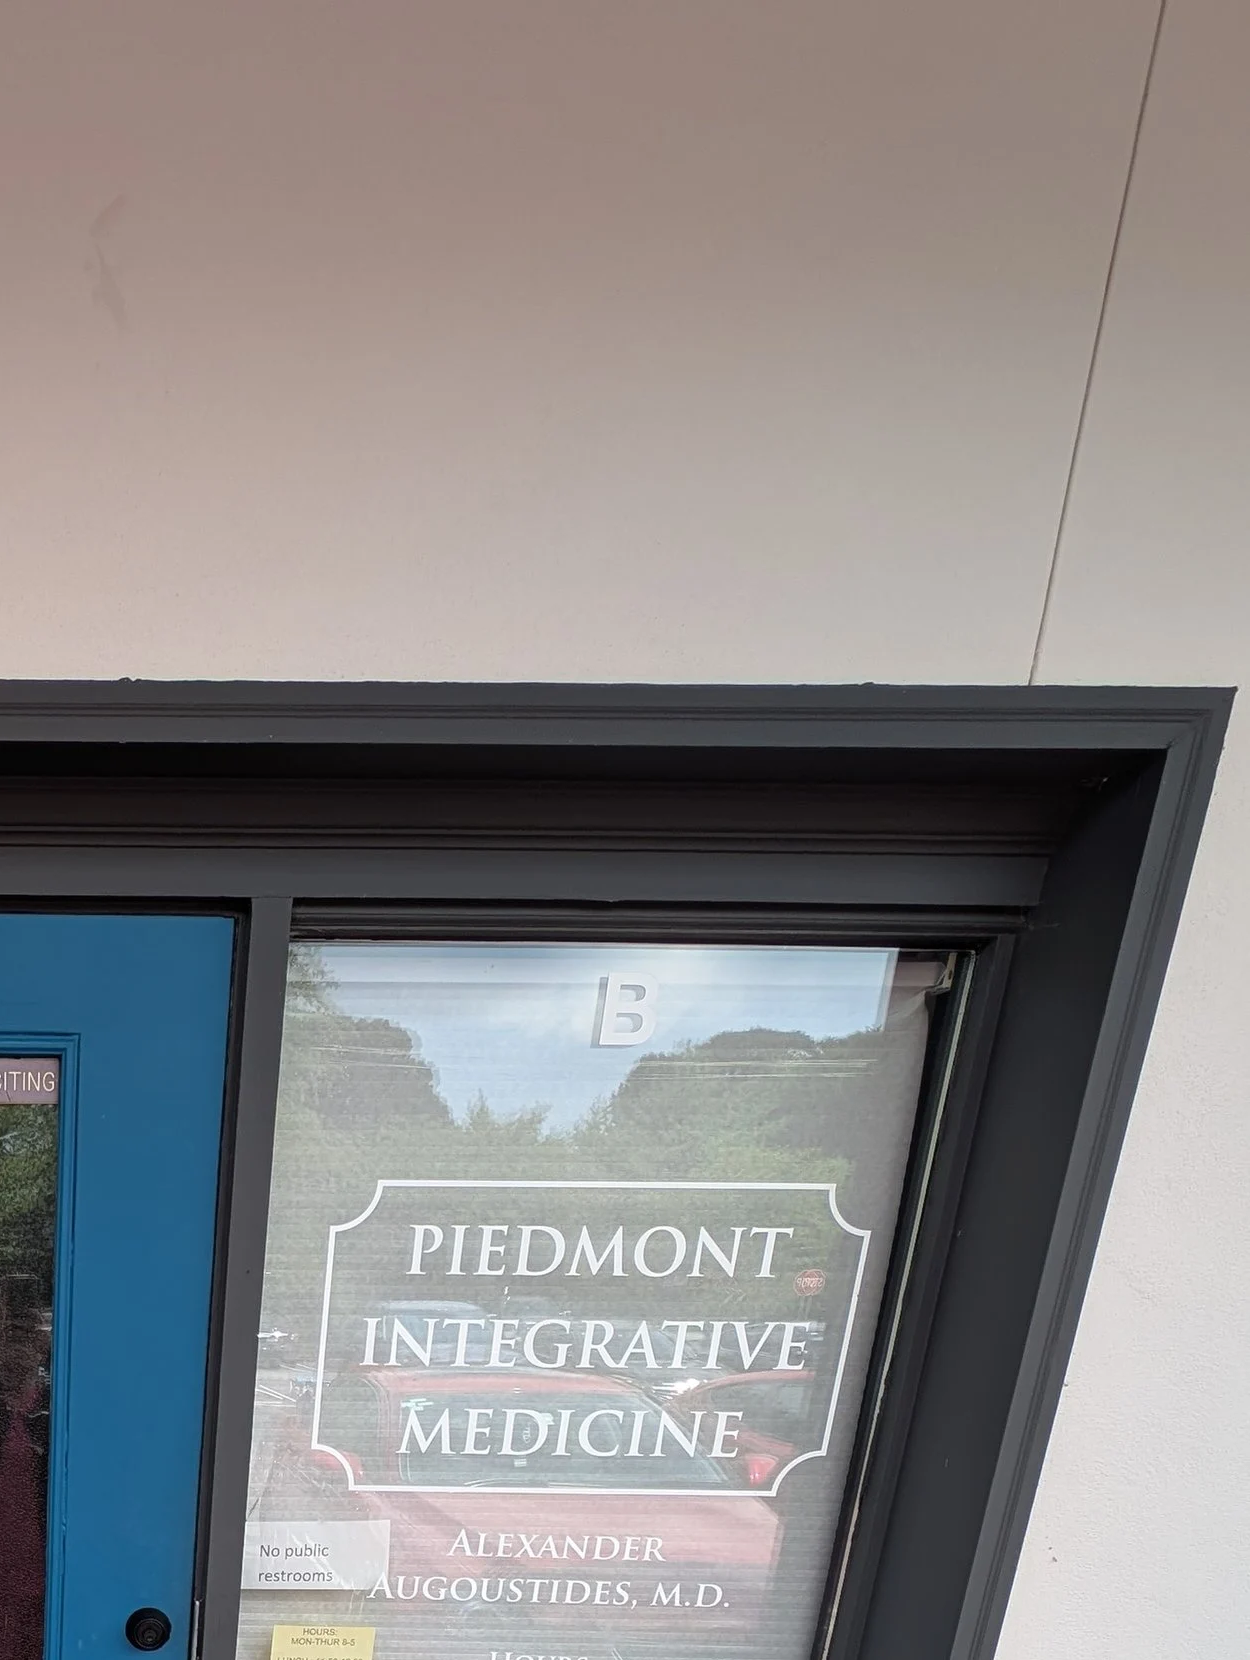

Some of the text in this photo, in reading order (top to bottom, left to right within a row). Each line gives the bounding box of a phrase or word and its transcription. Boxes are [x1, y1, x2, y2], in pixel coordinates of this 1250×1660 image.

[592, 971, 659, 1048] B
[406, 1224, 794, 1279] PIEDMONT
[359, 1317, 810, 1371] INTEGRATIVE
[397, 1408, 743, 1458] MEDICINE
[259, 1543, 329, 1560] No public
[447, 1529, 666, 1563] ALEXANDER
[258, 1569, 333, 1583] restrooms
[366, 1575, 732, 1609] AUGOUSTIDES, M.D.
[291, 1638, 340, 1646] MON-THUR
